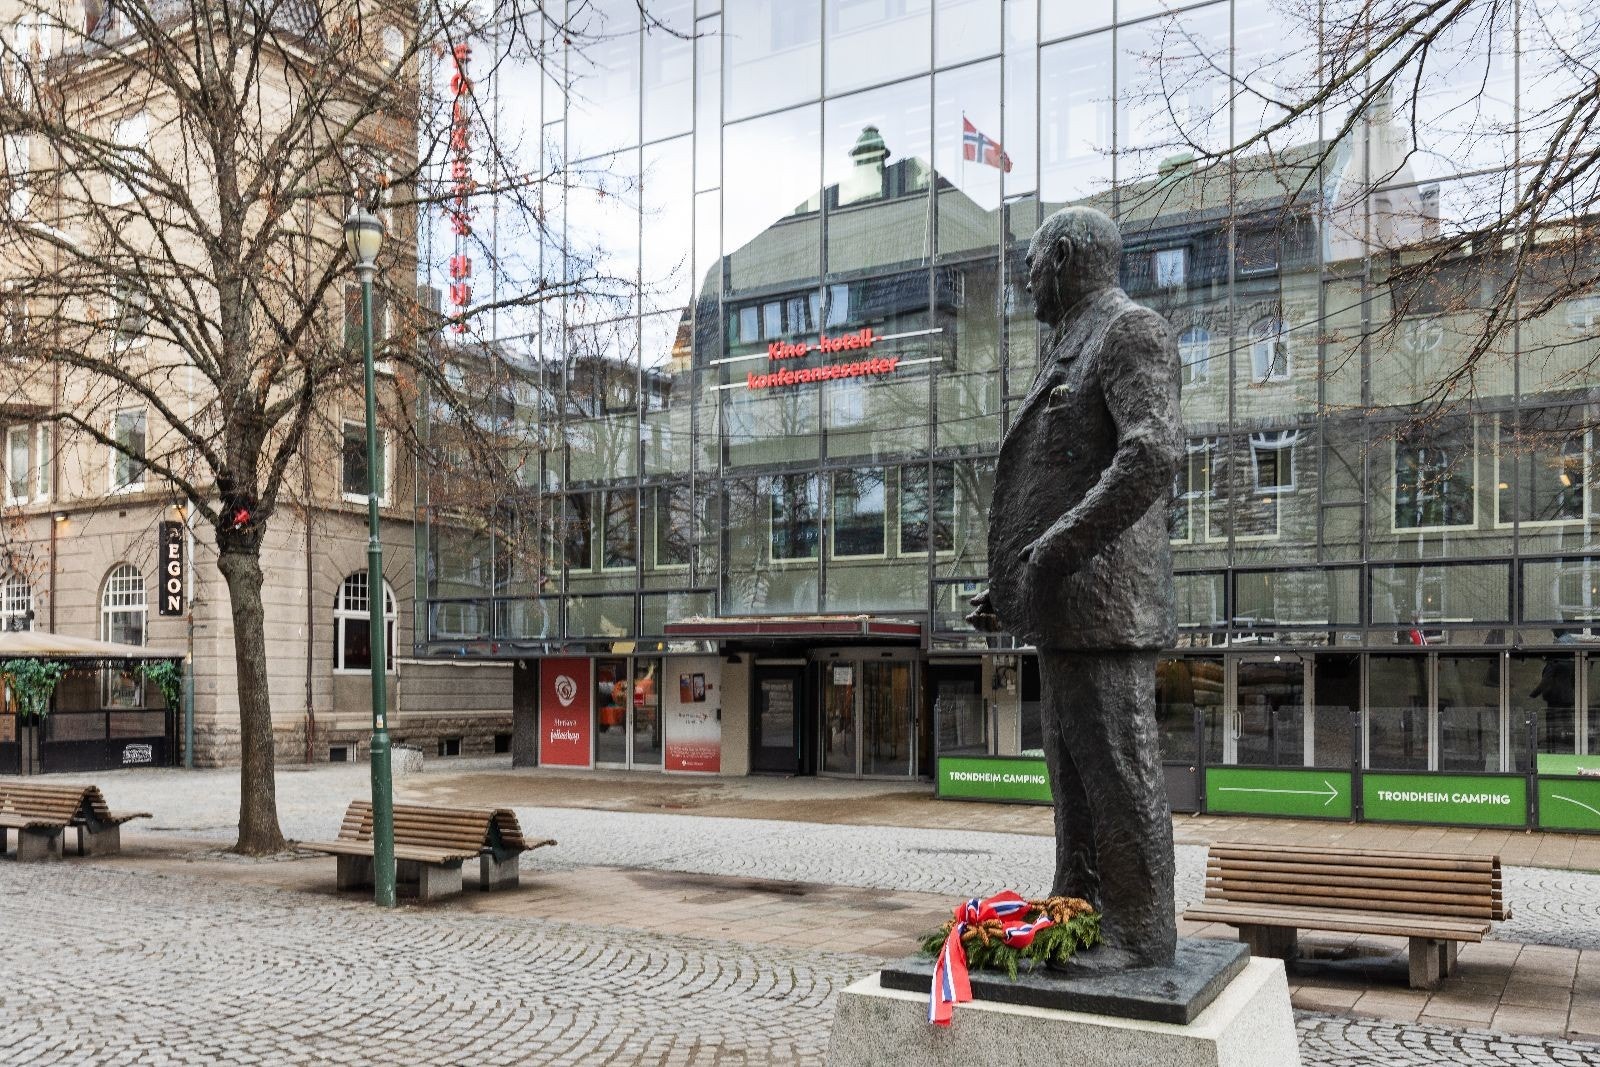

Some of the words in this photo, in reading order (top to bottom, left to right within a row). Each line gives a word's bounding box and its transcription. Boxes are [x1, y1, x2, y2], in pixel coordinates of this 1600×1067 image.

[768, 341, 807, 360] Kino
[820, 327, 873, 352] hotell
[747, 356, 899, 389] konferansesenter
[167, 543, 181, 611] EGON
[949, 772, 1001, 782] TRONDHEIM
[1003, 774, 1045, 785] CAMPING
[1377, 790, 1448, 803] TRONDHEIM
[1451, 793, 1511, 805] CAMPING
